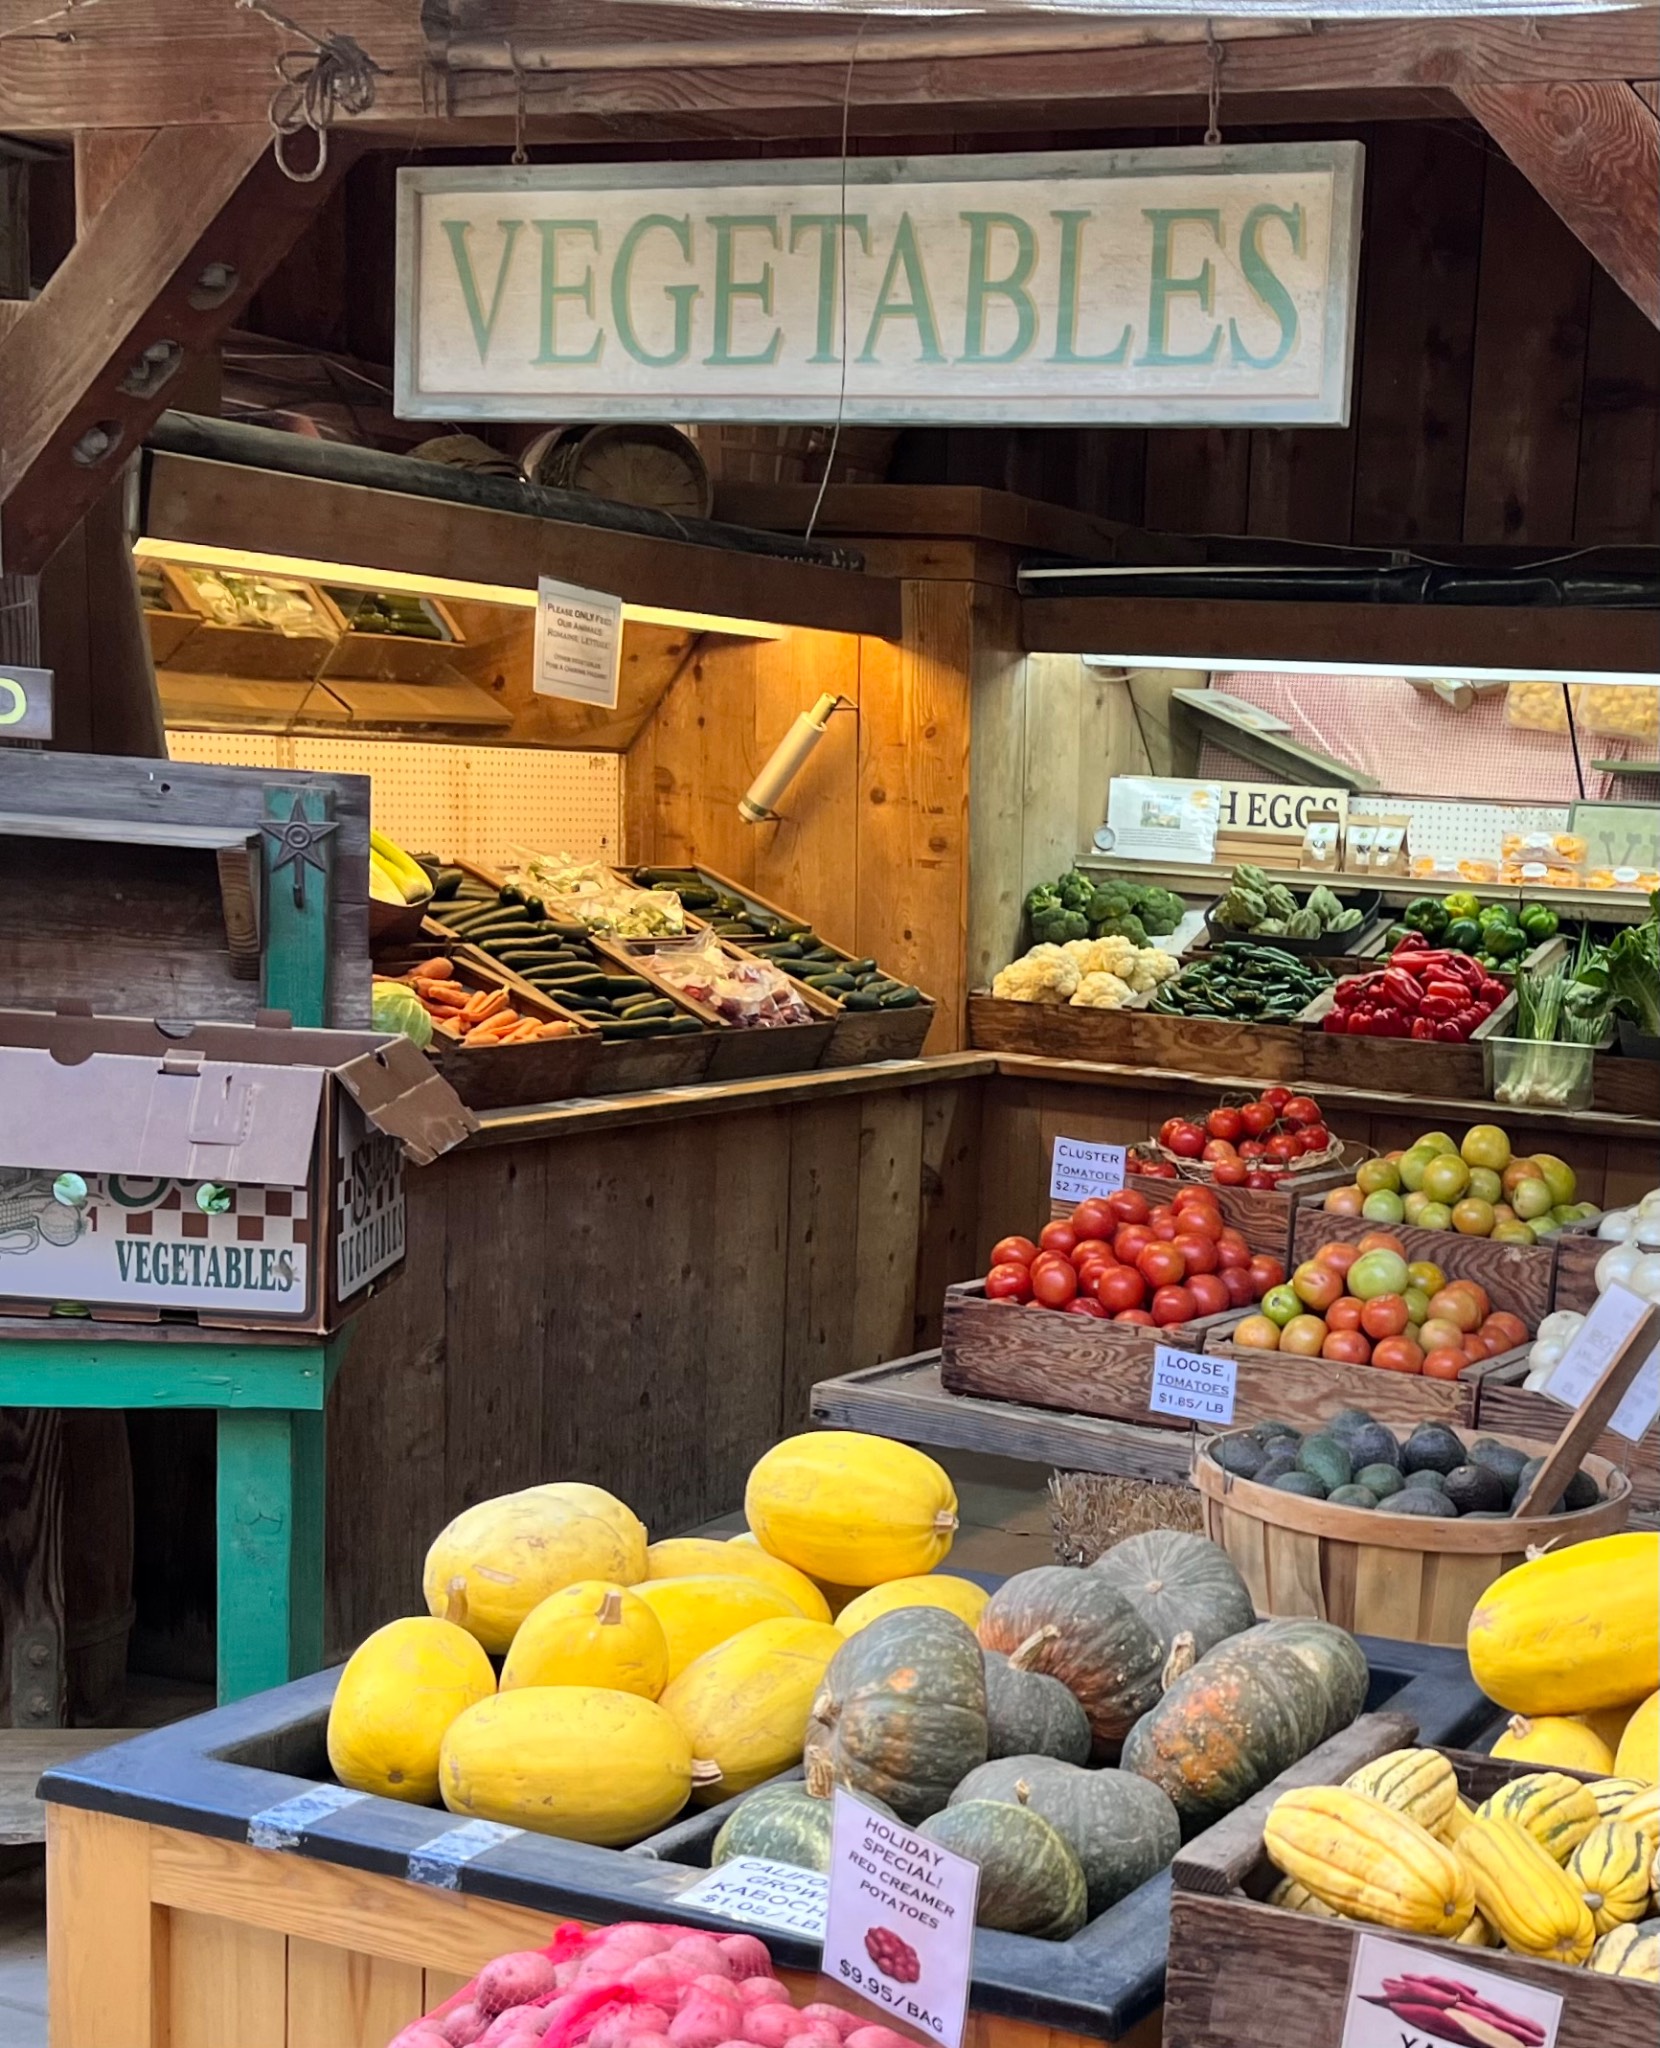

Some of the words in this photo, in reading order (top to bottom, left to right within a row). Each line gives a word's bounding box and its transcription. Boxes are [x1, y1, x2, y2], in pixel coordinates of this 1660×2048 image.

[440, 202, 1305, 370] VEGETABLES
[1056, 1163, 1120, 1181] TOMATOES
[1059, 1145, 1119, 1164] CLUSTER
[114, 1239, 294, 1292] VEGETABLES
[1157, 1372, 1229, 1396] TOMATOES
[1166, 1355, 1224, 1377] LOOSE
[862, 1836, 944, 1890] SPECIAL!
[865, 1817, 944, 1868] HOLIDAY
[739, 1861, 829, 1890] CALIFO
[848, 1850, 877, 1876] RED
[879, 1870, 956, 1919] CREAMER
[710, 1881, 828, 1920] KABOCH
[859, 1879, 941, 1930] POTATOES
